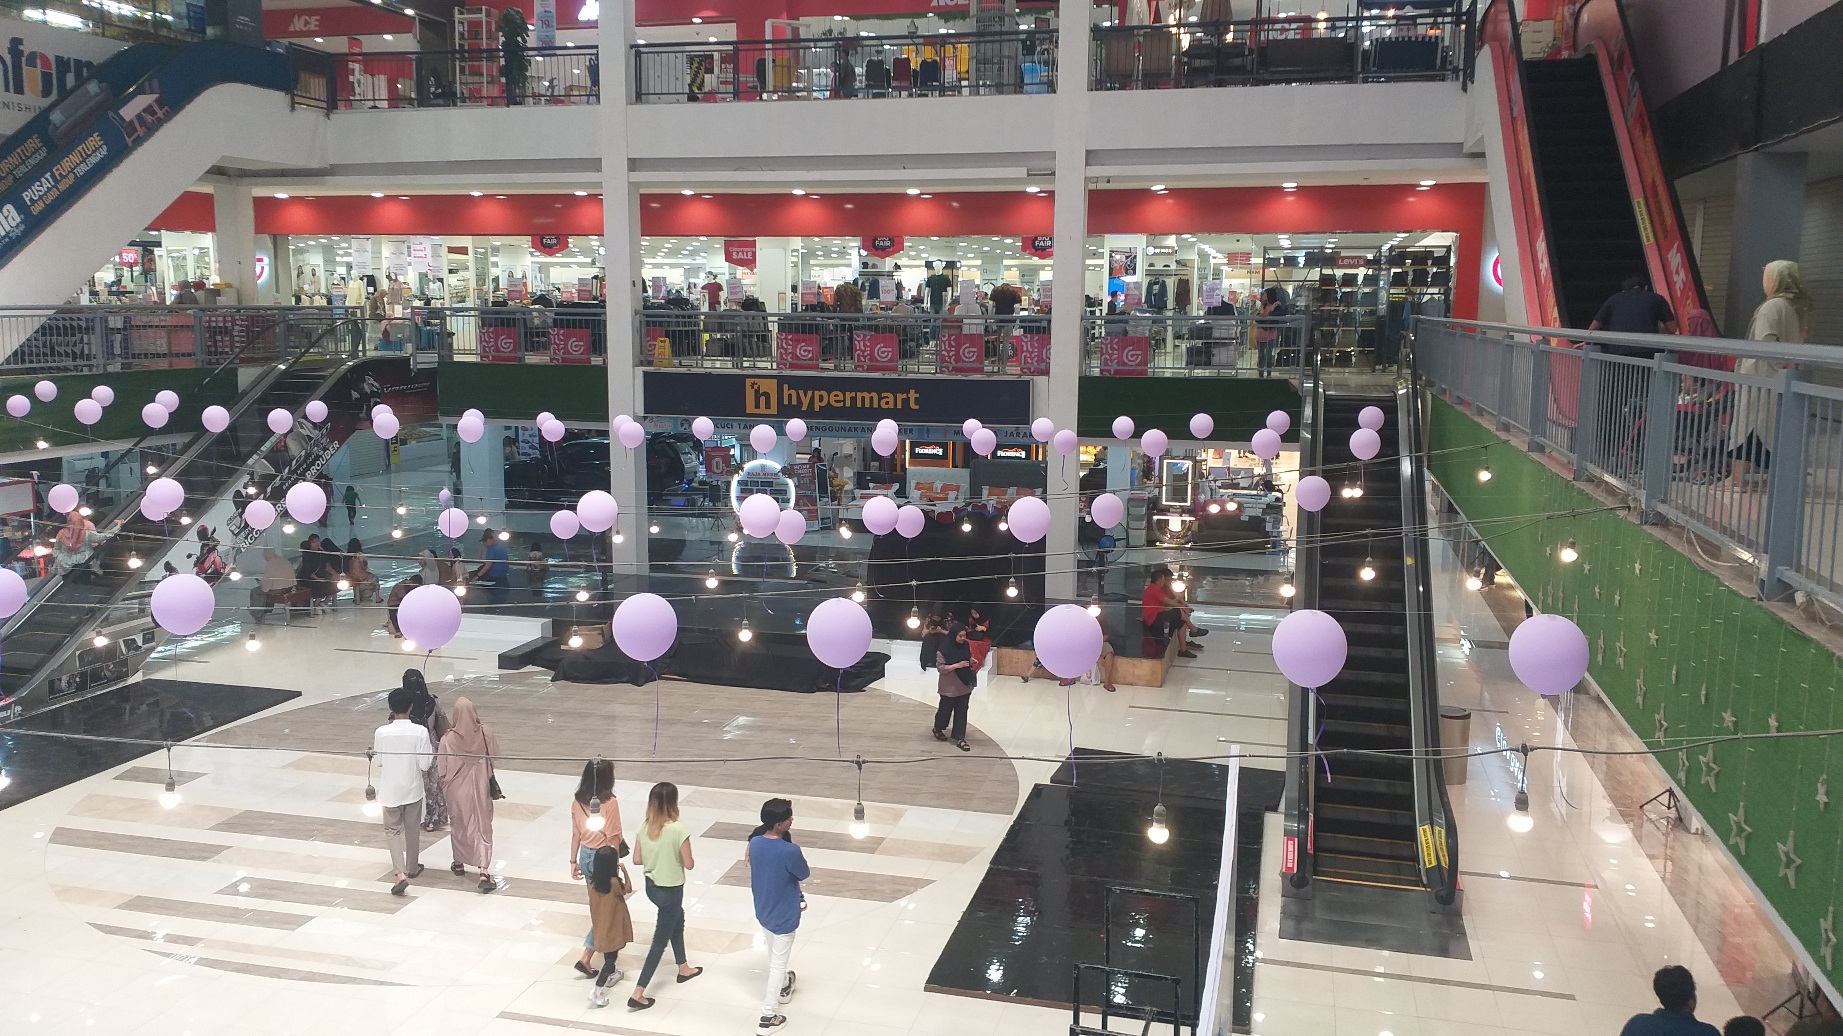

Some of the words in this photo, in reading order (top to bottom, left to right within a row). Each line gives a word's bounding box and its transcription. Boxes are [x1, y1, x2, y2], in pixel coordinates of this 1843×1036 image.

[288, 14, 320, 31] ACE
[21, 172, 55, 206] PUSAT
[52, 131, 104, 180] FURNITURE
[72, 144, 109, 178] TERLENGKAP
[732, 251, 753, 259] SALE
[783, 384, 920, 412] hypermart
[305, 440, 340, 480] PROUDER
